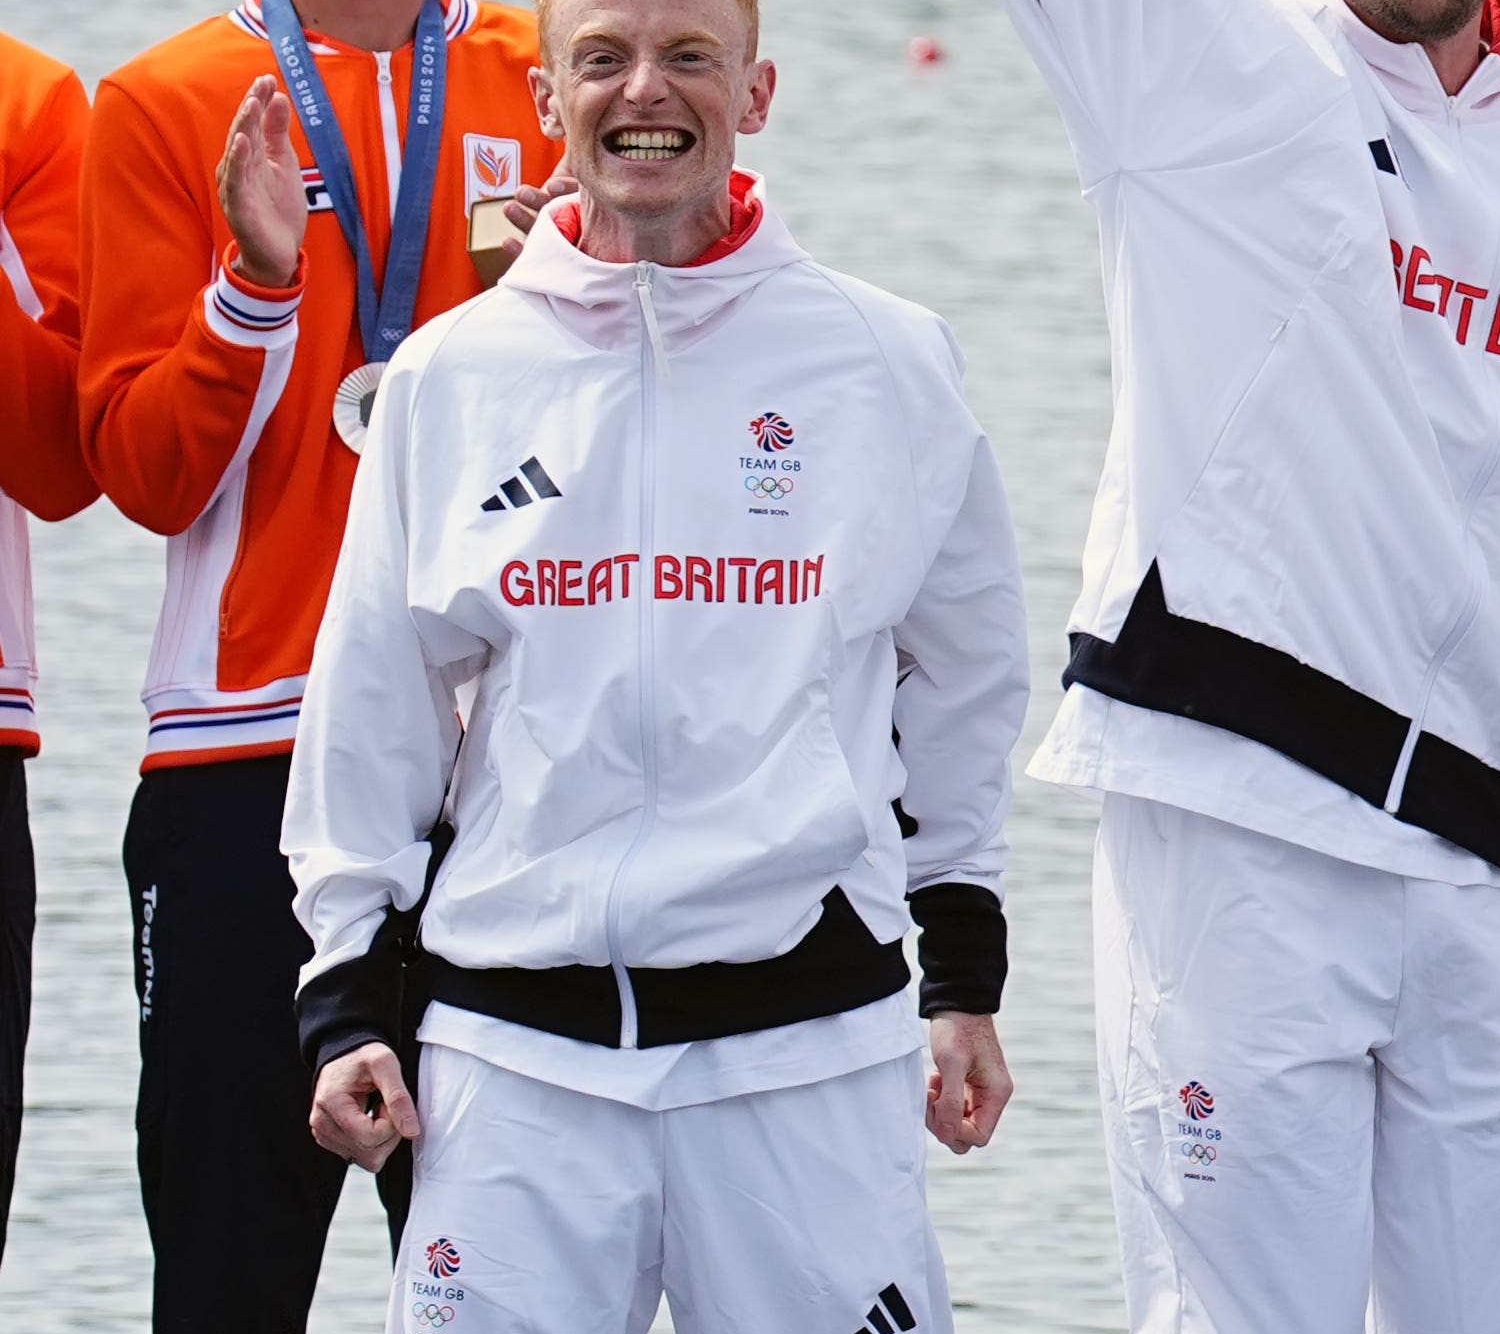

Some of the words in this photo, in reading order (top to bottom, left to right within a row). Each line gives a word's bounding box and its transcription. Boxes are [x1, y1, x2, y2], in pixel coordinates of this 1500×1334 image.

[280, 36, 303, 77] 2024
[422, 35, 435, 75] 2024
[296, 80, 323, 127] PARIS
[417, 79, 433, 125] PARIS
[739, 457, 777, 470] TEAM
[781, 460, 801, 472] GB
[500, 553, 640, 606] GREAT
[654, 554, 824, 605] BRITAIN
[1178, 1123, 1202, 1138] TEAM
[1205, 1128, 1222, 1140] GB
[412, 1282, 441, 1298] TEAM
[444, 1288, 465, 1301] GB
